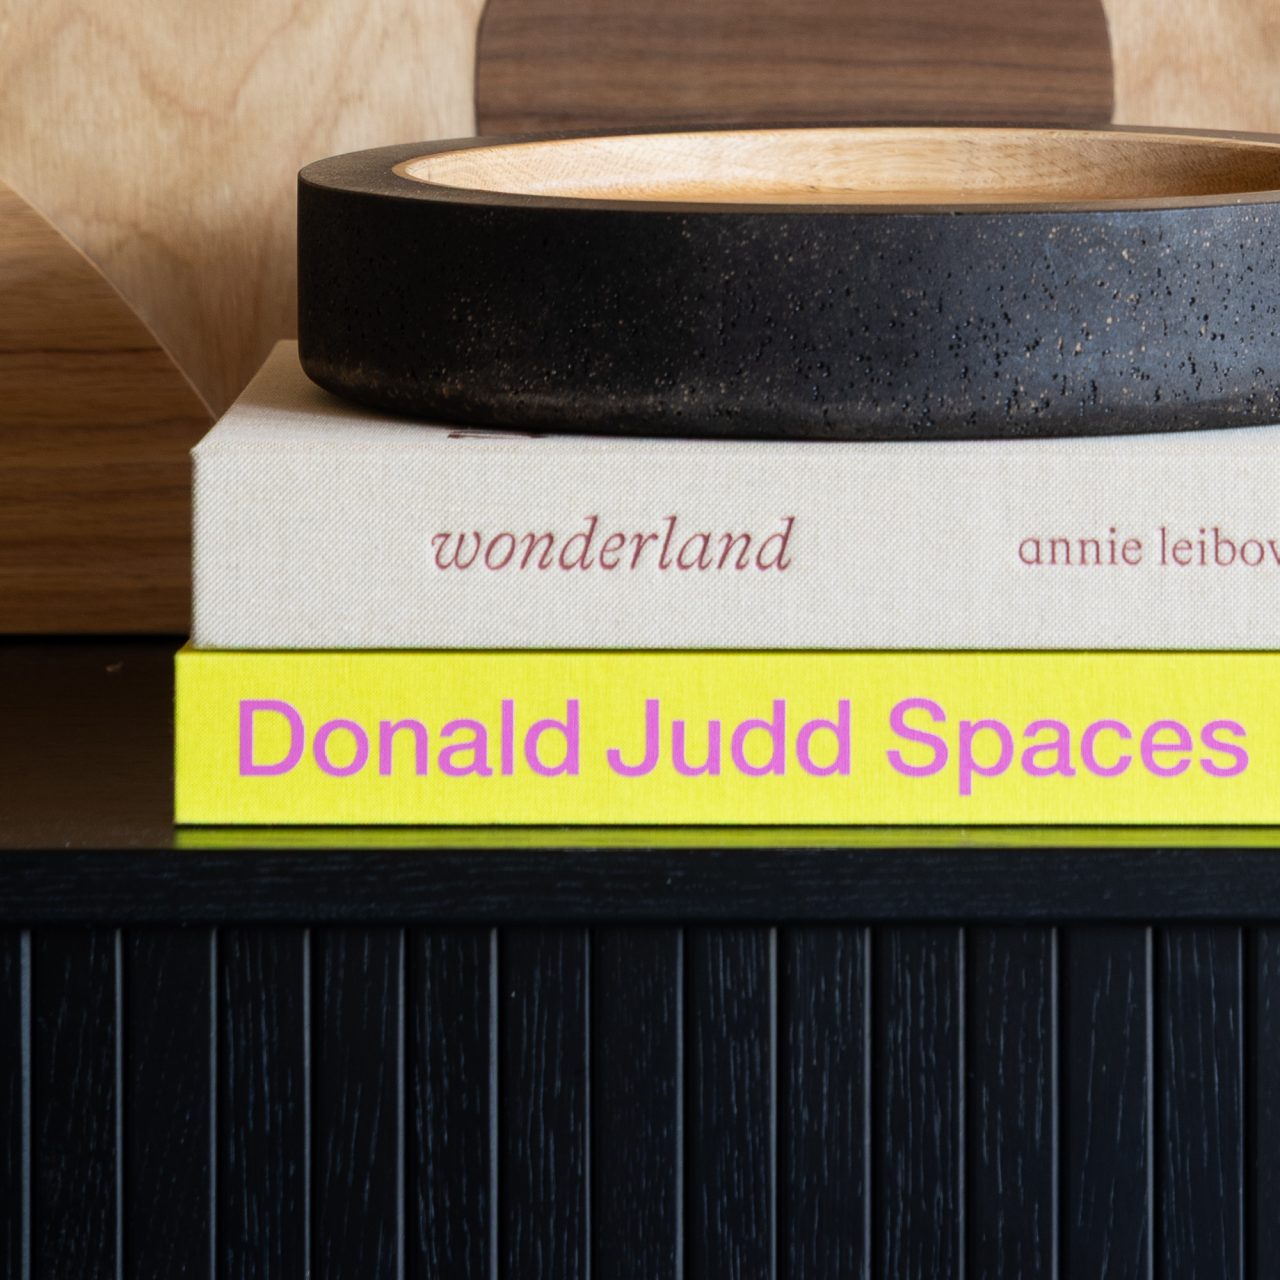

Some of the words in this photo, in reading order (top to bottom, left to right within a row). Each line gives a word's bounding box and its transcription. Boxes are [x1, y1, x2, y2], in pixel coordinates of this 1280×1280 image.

[431, 515, 795, 572] wonderland
[1019, 526, 1143, 567] annie
[239, 698, 581, 776] Donald
[606, 698, 852, 776] Judd
[886, 697, 1250, 796] Spaces
